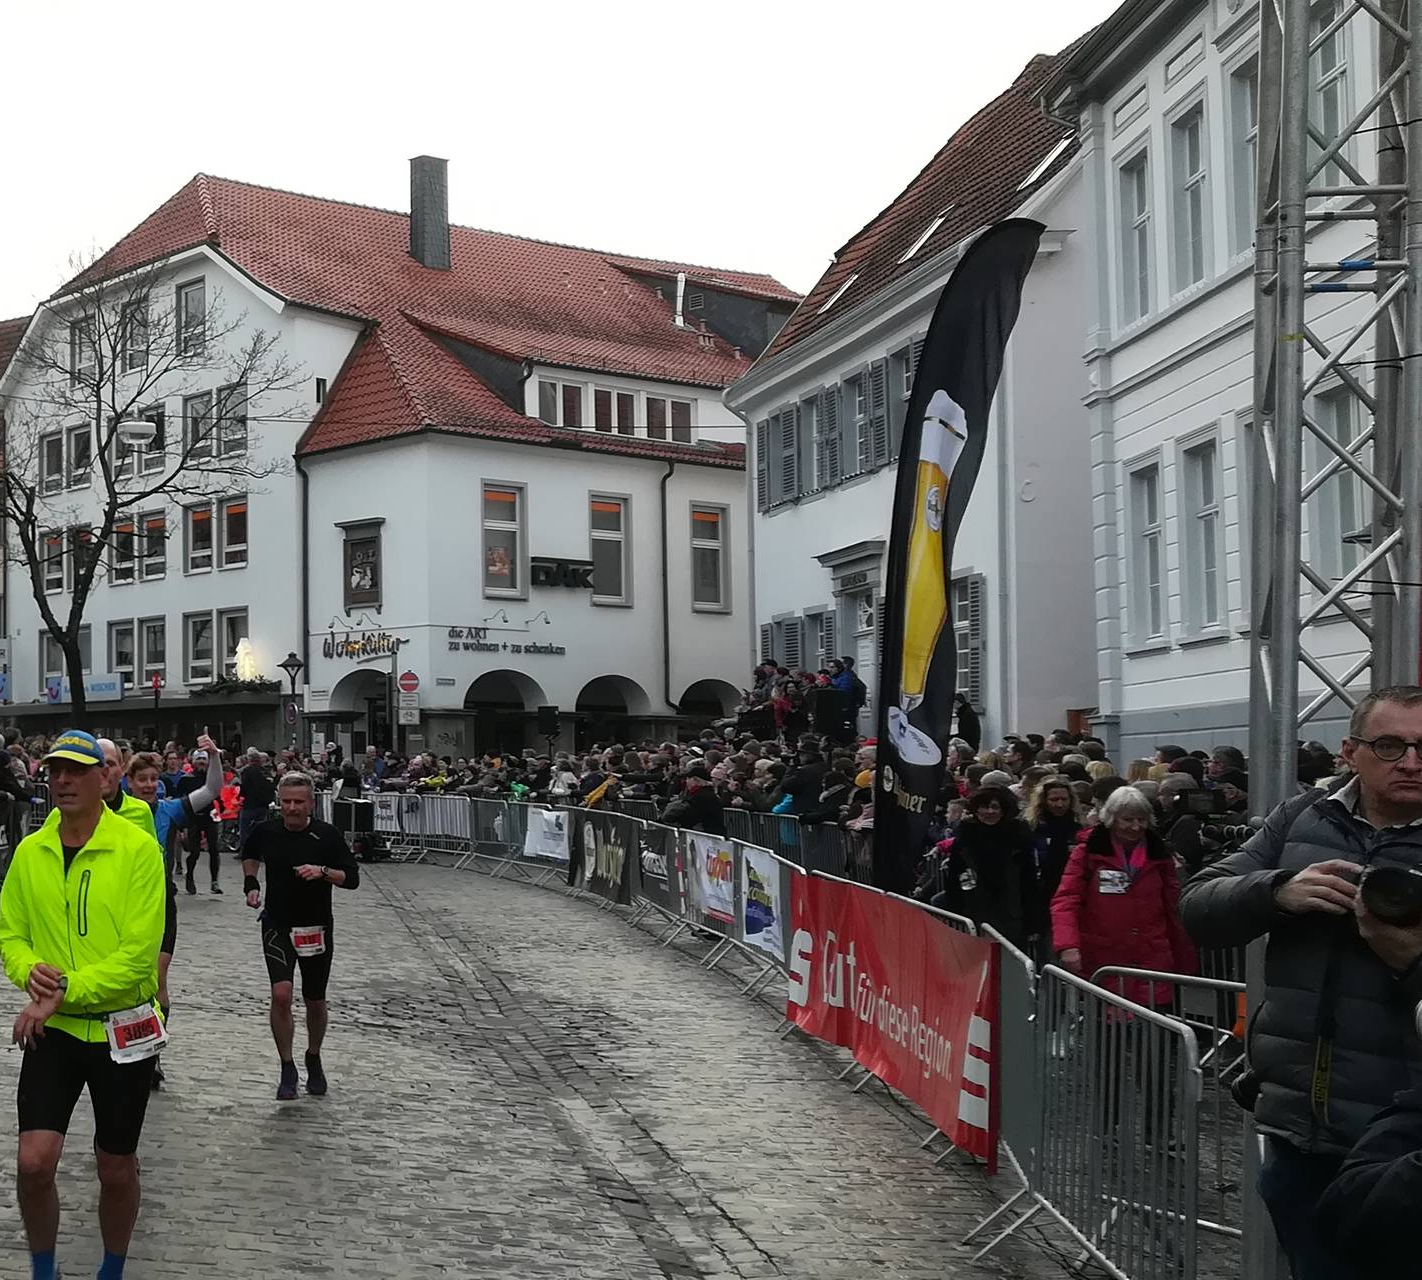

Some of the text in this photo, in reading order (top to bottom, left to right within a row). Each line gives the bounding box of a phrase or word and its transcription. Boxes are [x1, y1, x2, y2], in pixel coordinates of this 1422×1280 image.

[448, 626, 488, 640] die ART
[448, 641, 460, 651] zu
[462, 639, 499, 652] wohnen
[510, 643, 522, 653] zu
[523, 641, 566, 656] schenken
[855, 973, 877, 1024] für
[878, 985, 910, 1048] diese
[910, 1004, 952, 1082] Region.
